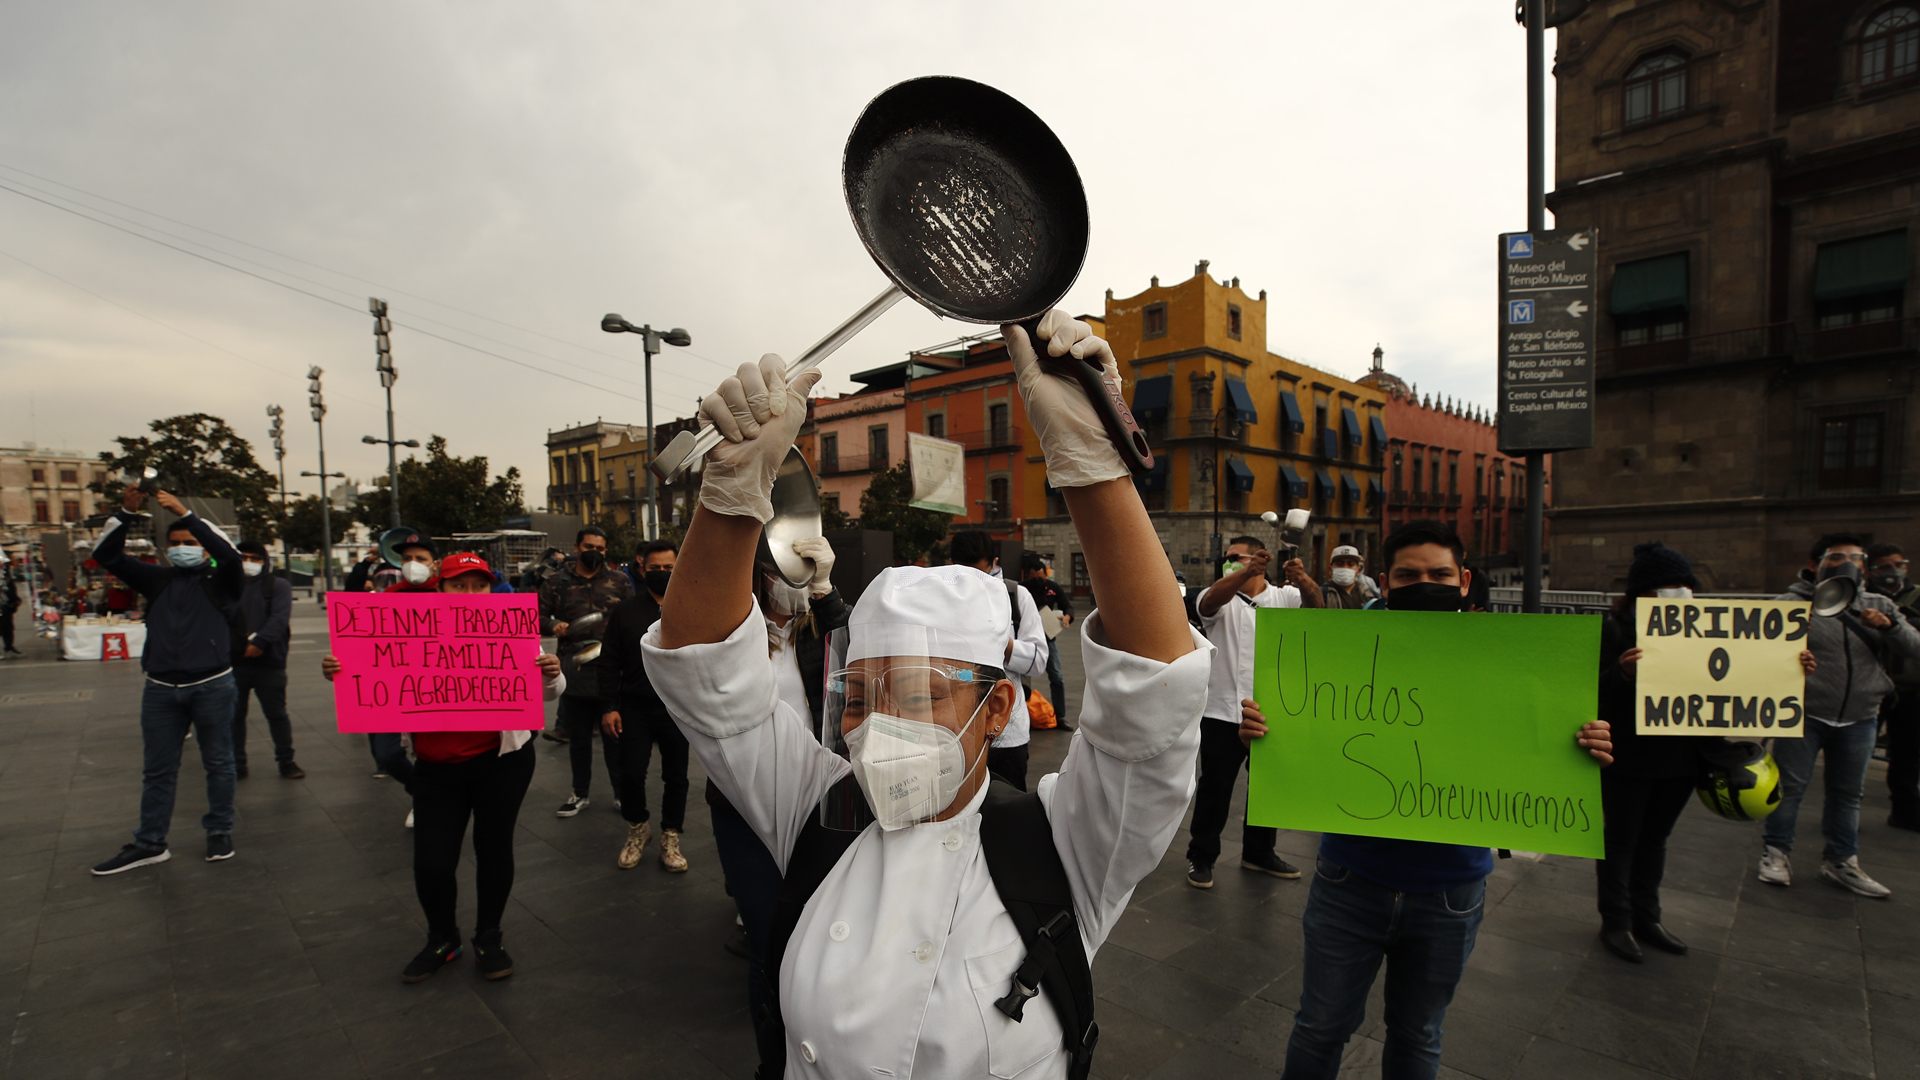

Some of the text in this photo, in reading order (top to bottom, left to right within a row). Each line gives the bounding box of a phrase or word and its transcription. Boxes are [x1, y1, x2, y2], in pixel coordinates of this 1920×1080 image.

[1508, 260, 1566, 274] Museo del
[1508, 273, 1587, 287] Templo Mayor
[1508, 329, 1580, 342] Antiguo Colegio
[1508, 340, 1585, 353] de San Ildefonso
[1507, 356, 1587, 369] Museo Archivo de
[1508, 370, 1517, 380] la
[1103, 381, 1133, 424] EKCO
[1508, 388, 1588, 400] Centro Cultural de
[1509, 400, 1588, 414] España en México
[450, 605, 541, 637] TRABAJAR
[1646, 604, 1809, 642] ABRIMOS
[372, 641, 518, 670] MI FAMILIA
[1708, 646, 1731, 682] O
[352, 674, 389, 709] LO
[1277, 631, 1425, 728] Unidos
[1645, 693, 1803, 729] MORIMOS
[1337, 733, 1591, 834] Sobreviviremos
